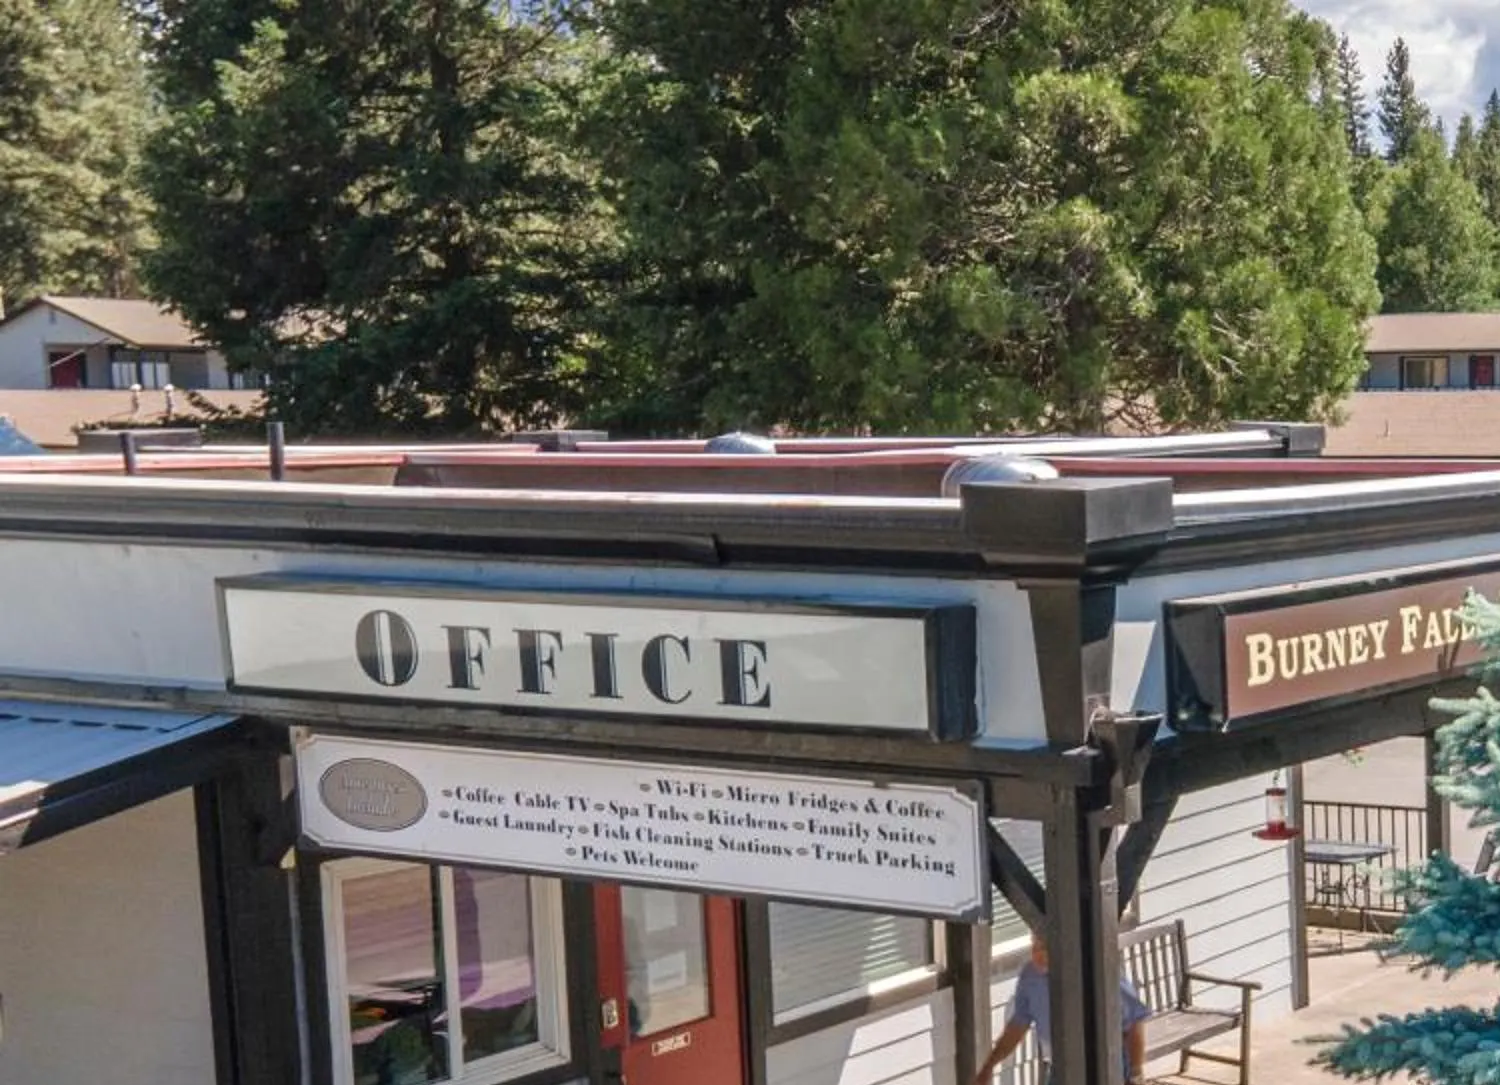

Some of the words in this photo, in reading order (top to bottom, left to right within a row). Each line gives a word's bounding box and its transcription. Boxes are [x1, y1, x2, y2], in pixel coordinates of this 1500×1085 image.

[355, 609, 772, 708] OFFICE
[1245, 619, 1389, 687] BURNEY
[1399, 603, 1484, 654] FALL
[455, 786, 505, 806] Coffee
[514, 788, 561, 811] Cable
[565, 795, 591, 813] TV
[608, 801, 640, 820] Spa
[644, 803, 690, 822] Tubs
[707, 808, 789, 832] Kitchens
[807, 818, 870, 843] Family
[876, 825, 937, 846] Suites
[656, 779, 708, 799] Wi-Fi
[726, 785, 781, 805] Micro
[787, 791, 859, 814] Fridges
[863, 798, 881, 815] &
[885, 799, 946, 820] Coffee
[452, 806, 499, 829] Guest
[503, 814, 575, 839] Laundry
[592, 822, 631, 841] Fish
[635, 826, 714, 852] Cleaning
[718, 835, 793, 857] Stations
[811, 842, 870, 865] Truck
[875, 851, 956, 877] Parking
[581, 845, 619, 864] Pets
[623, 850, 700, 872] Welcome
